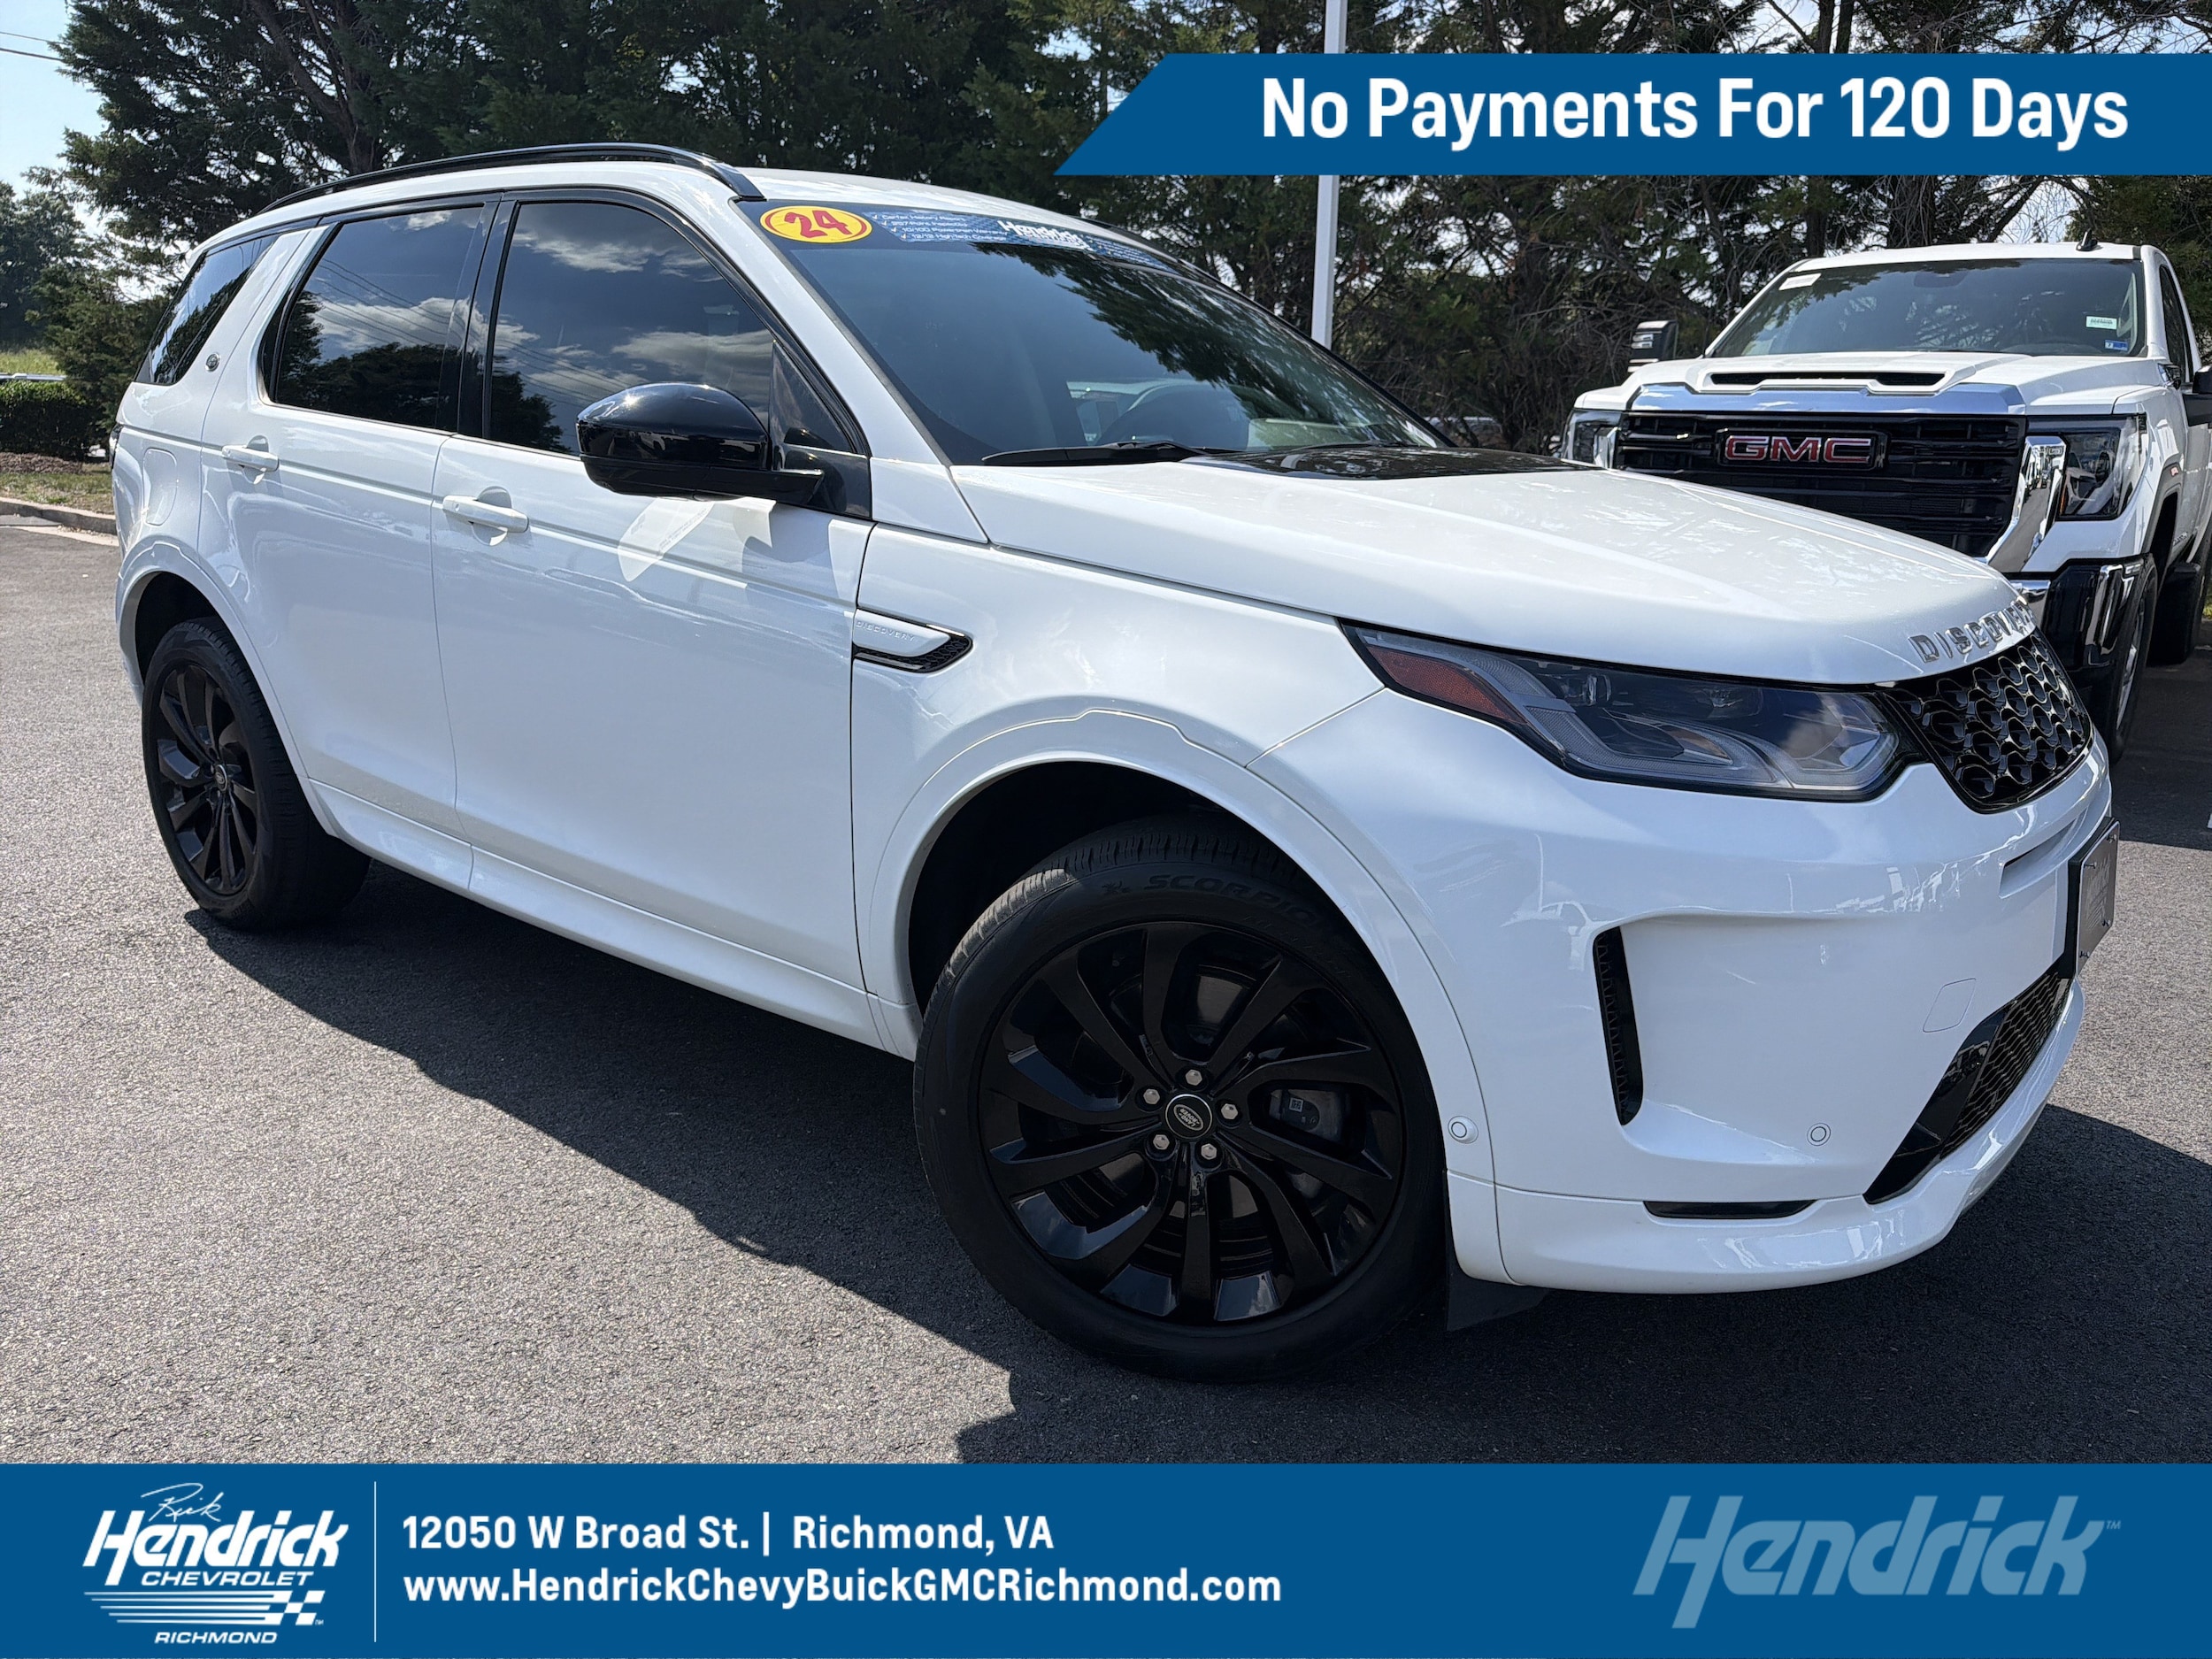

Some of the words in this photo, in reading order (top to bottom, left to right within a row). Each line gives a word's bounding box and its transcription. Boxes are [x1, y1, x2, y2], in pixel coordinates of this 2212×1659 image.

[784, 210, 852, 238] 24
[1725, 435, 1871, 463] GMC
[856, 620, 915, 642] DISCOVERY
